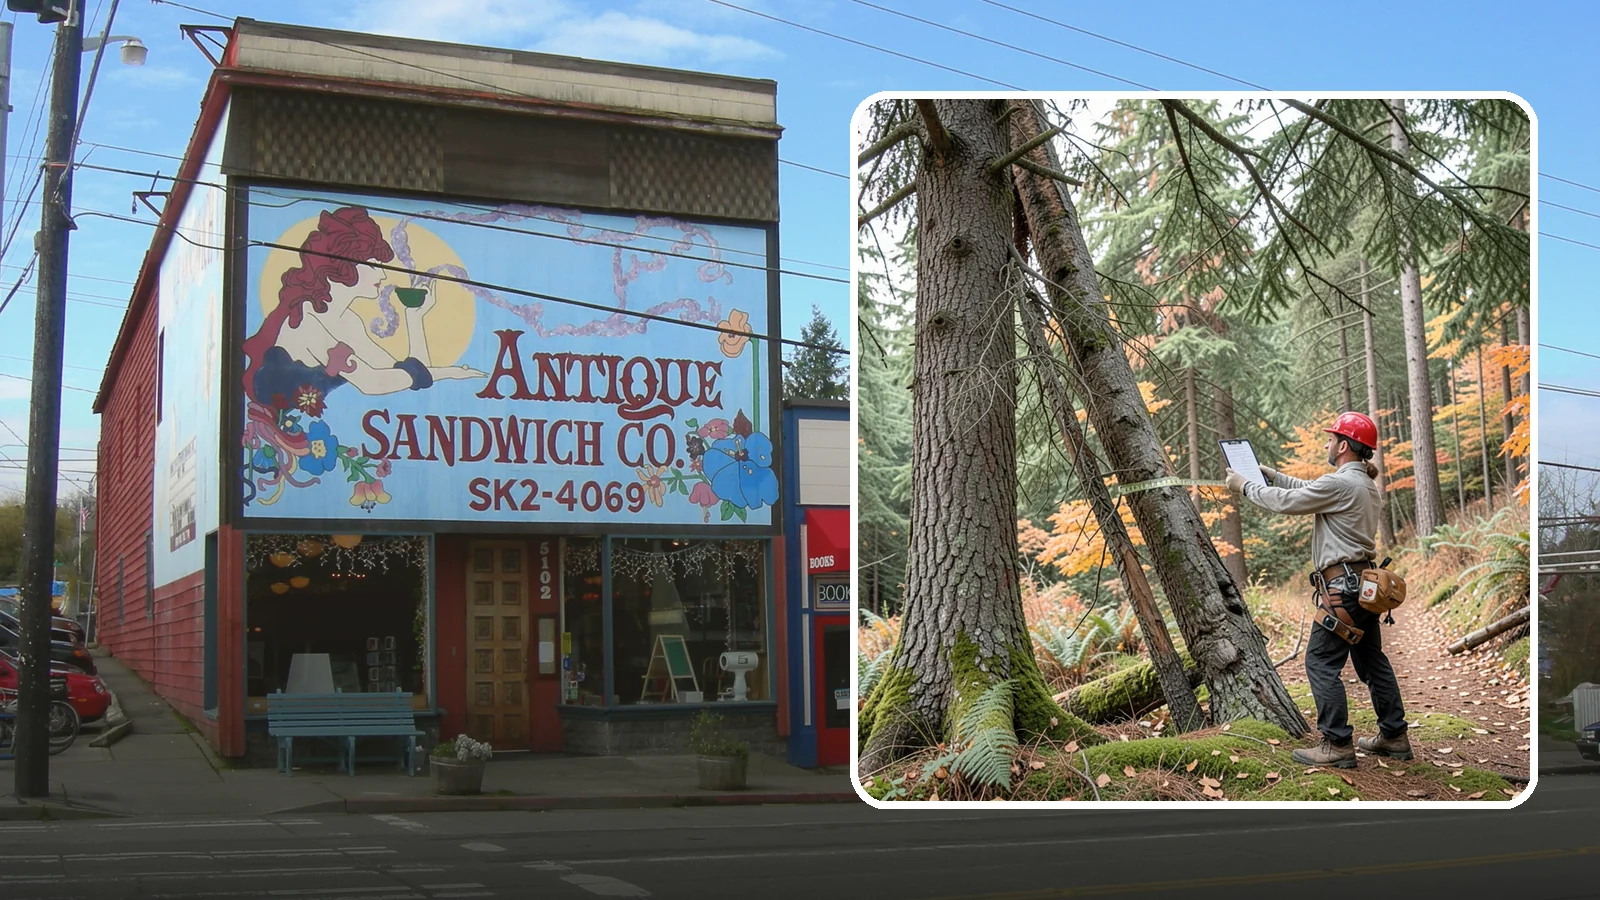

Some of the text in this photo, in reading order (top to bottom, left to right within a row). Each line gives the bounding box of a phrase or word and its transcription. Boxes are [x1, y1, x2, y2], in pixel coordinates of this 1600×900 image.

[476, 329, 723, 420] ANTIQUE
[361, 409, 685, 468] SANDWICH CO.
[469, 478, 645, 512] SK2-4069
[540, 541, 551, 599] 5102
[809, 555, 835, 569] BOOKS
